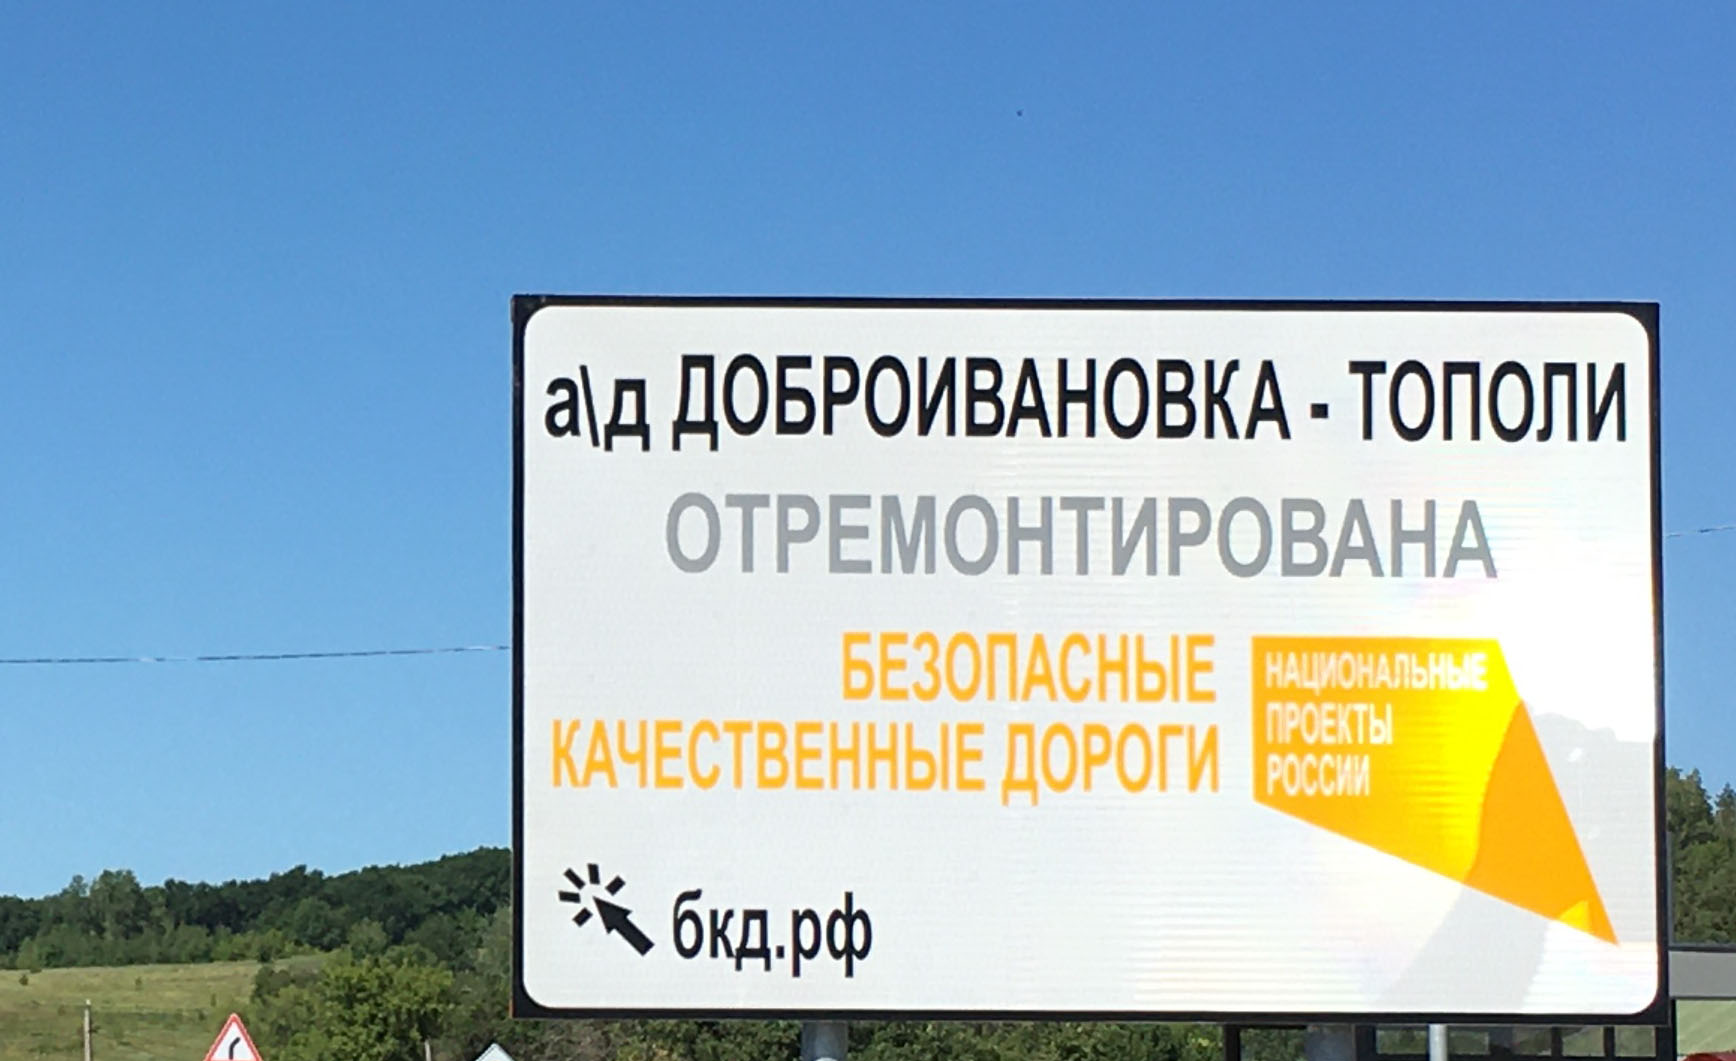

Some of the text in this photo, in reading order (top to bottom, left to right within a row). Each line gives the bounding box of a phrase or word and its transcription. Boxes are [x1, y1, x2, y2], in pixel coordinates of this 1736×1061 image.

[672, 353, 1291, 452] ДОБРОИВАНОВКА
[1348, 359, 1627, 443] ТОПОЛИ
[666, 492, 1499, 579] ОТРЕМОНТИРОВАНА
[842, 631, 1217, 703] БЕЗОПАСНЫЕ
[1265, 651, 1489, 696] НАЦИОНАЛЬНЫЕ
[551, 719, 1220, 806] КАЧЕСТВЕННЫЕ ДОРОГИ
[1266, 701, 1394, 745] ПРОЕКТЫ
[1266, 753, 1371, 797] РОССИИ
[672, 887, 873, 978] бкд.рф
